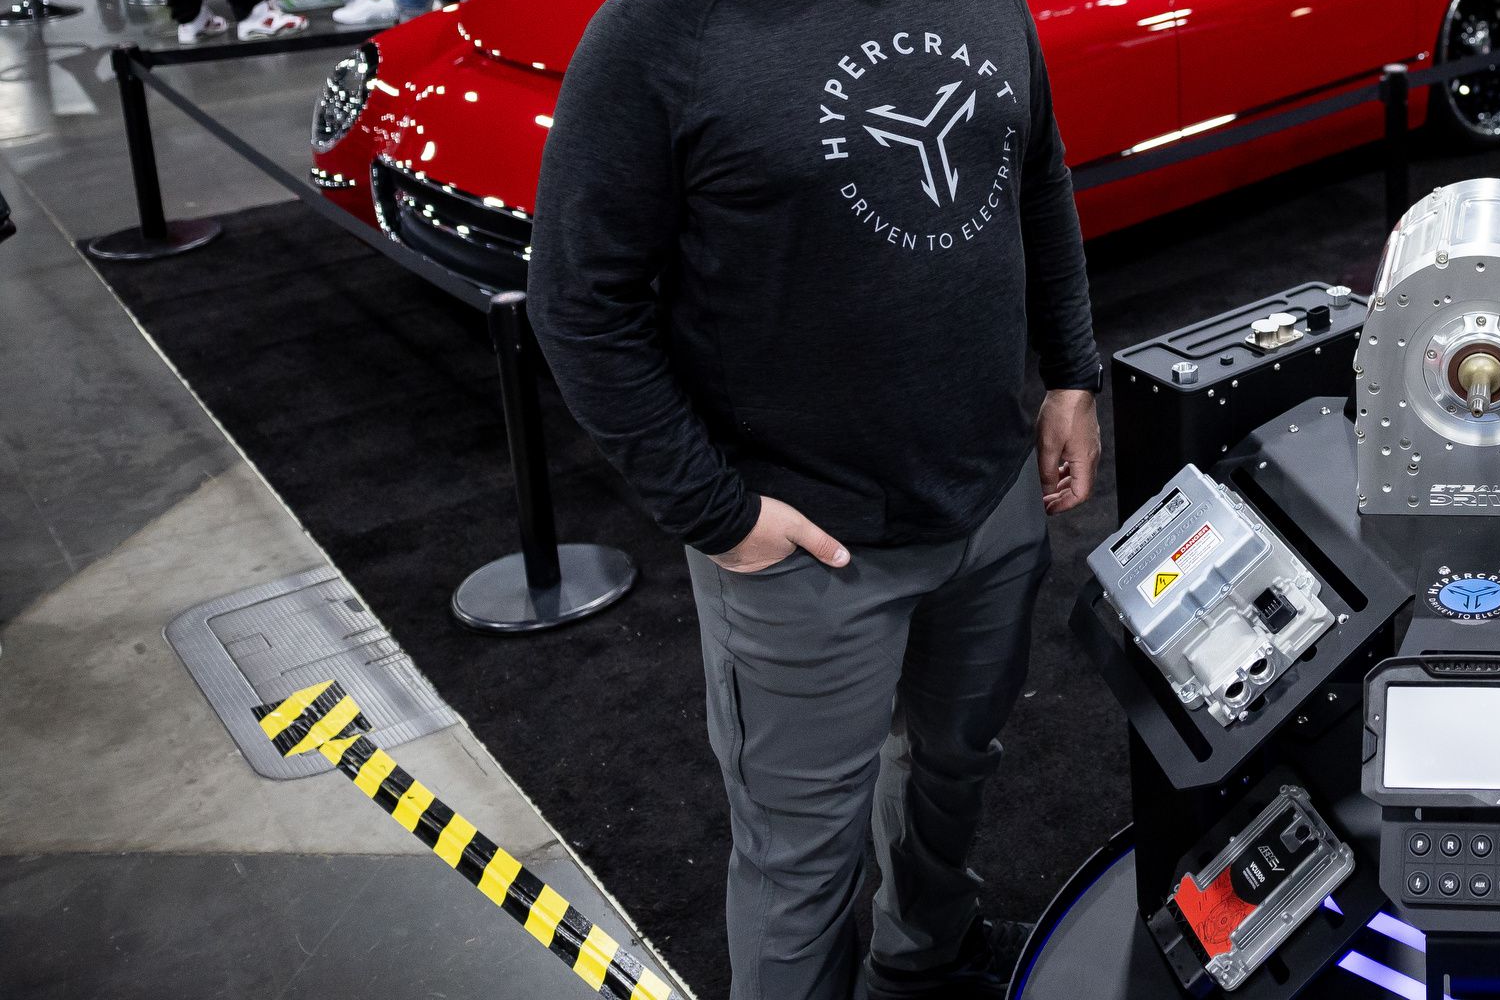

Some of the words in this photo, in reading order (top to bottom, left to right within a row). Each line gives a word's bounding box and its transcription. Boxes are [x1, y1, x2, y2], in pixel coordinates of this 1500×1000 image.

[819, 32, 1014, 160] HYPERCRAFT
[840, 182, 917, 250] DRIVEN
[927, 232, 953, 251] TO
[961, 126, 1016, 241] ELECTRIFY
[1179, 525, 1209, 553] DANGER
[1428, 597, 1455, 617] DRIVEN
[1417, 840, 1424, 849] P
[1447, 841, 1454, 850] R
[1477, 841, 1484, 850] N
[1250, 861, 1266, 883] VCU300
